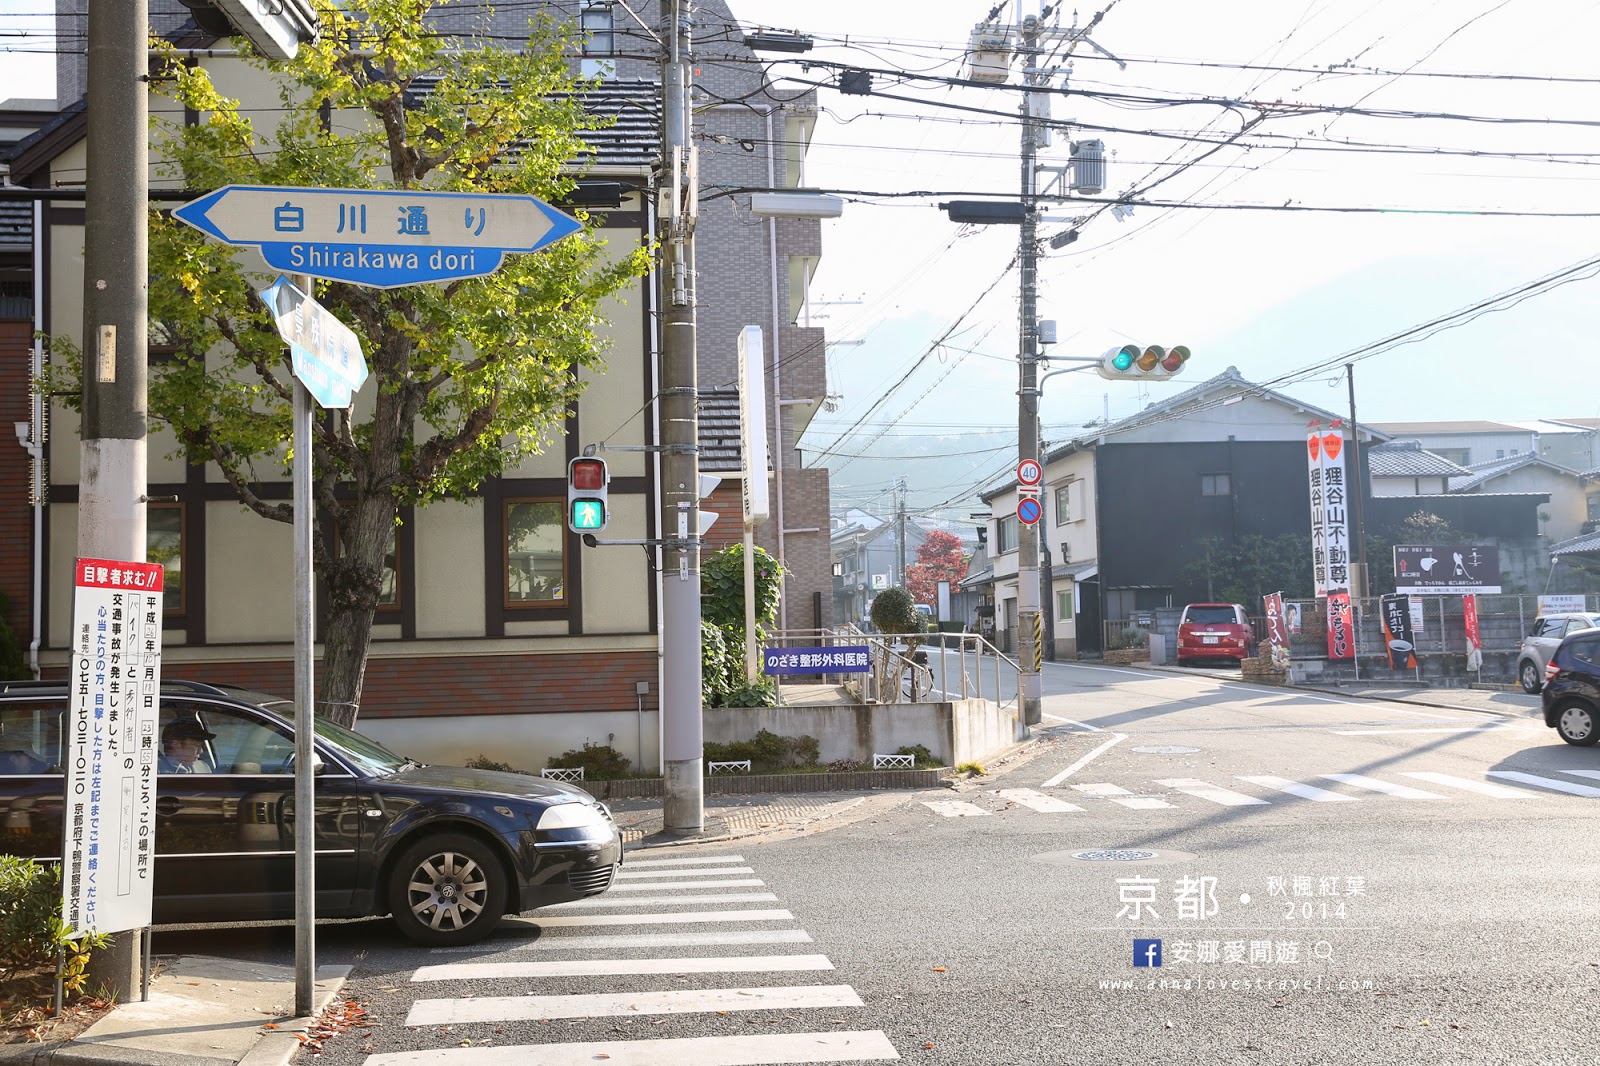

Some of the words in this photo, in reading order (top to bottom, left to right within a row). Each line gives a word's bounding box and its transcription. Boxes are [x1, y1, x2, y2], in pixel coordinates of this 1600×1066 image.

[274, 201, 487, 237] 白川通り
[290, 244, 419, 271] Shirakawa
[428, 248, 476, 271] dori
[1022, 466, 1037, 480] 40
[1310, 467, 1326, 585] 狸谷山不動尊
[1325, 467, 1348, 585] 狸谷山不動尊
[875, 575, 882, 584] P
[767, 652, 868, 668] のざき整形外科医院
[108, 594, 122, 757] 交通事故が発生しました。
[127, 666, 137, 678] と
[124, 758, 134, 769] の
